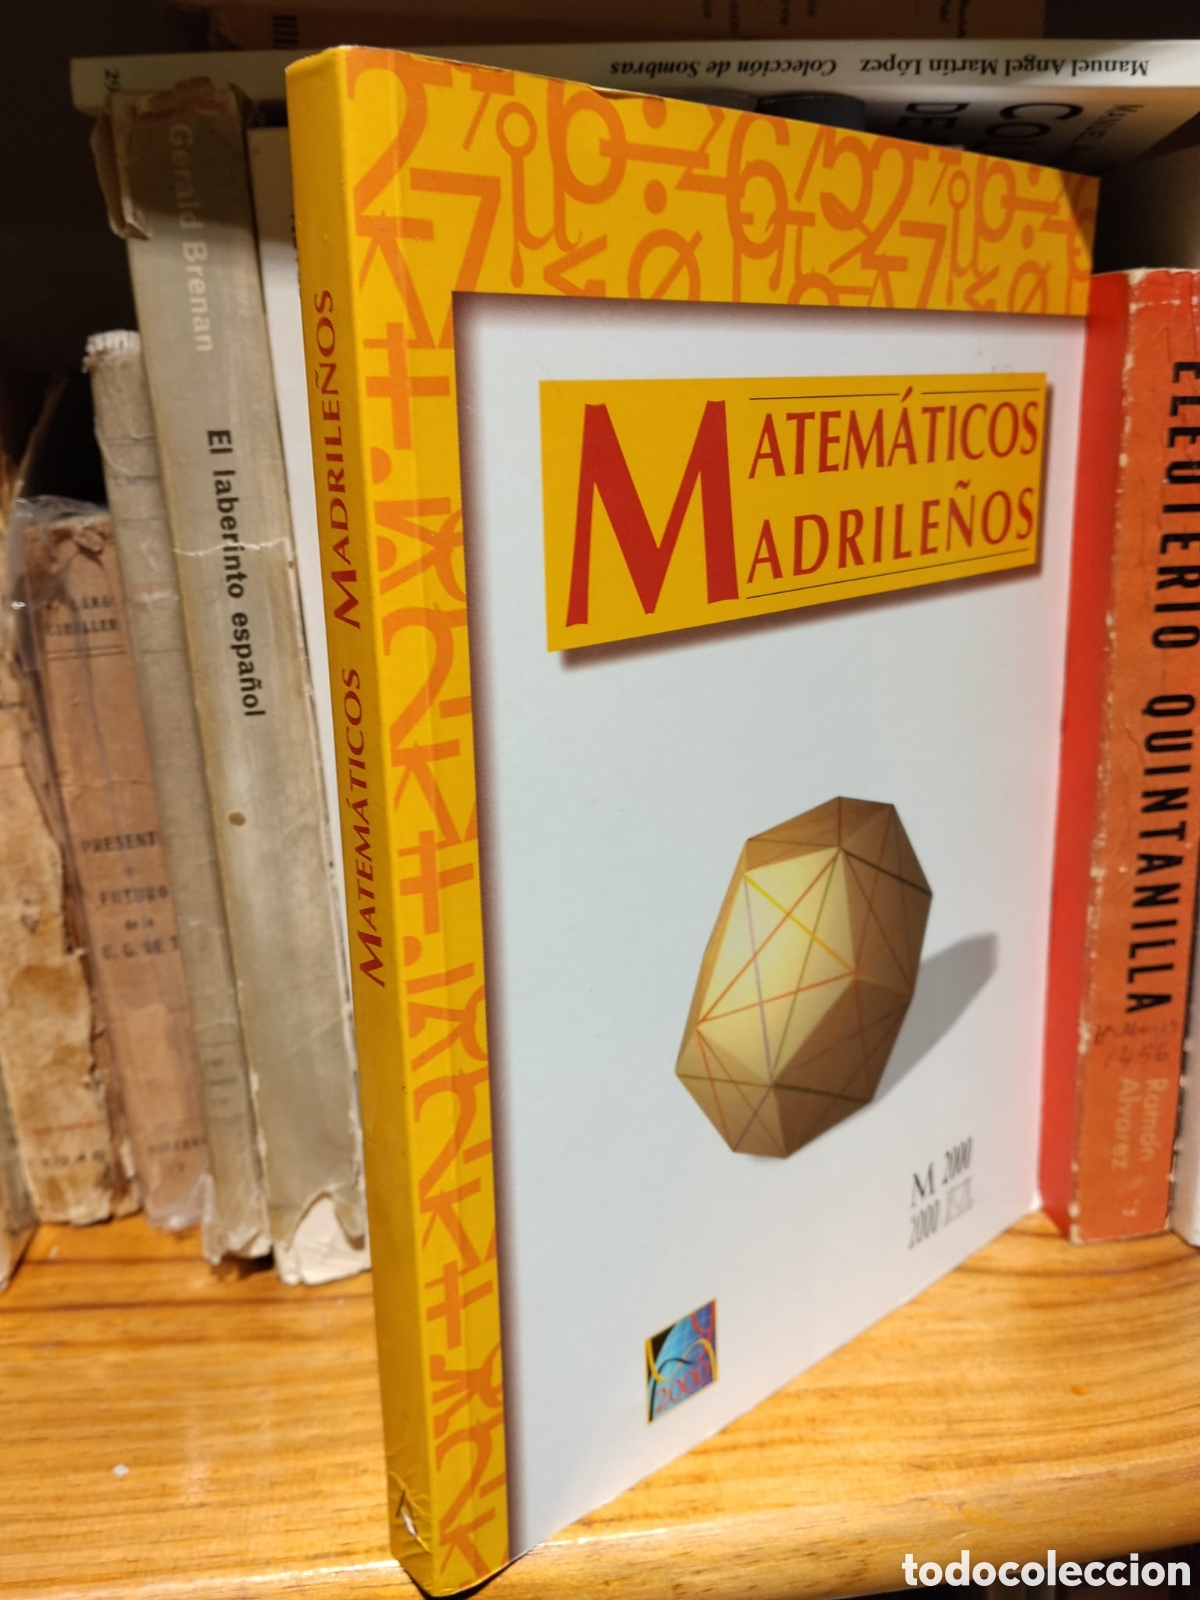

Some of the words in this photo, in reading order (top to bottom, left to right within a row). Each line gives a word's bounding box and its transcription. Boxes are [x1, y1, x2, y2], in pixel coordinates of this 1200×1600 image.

[610, 59, 700, 78] Sombras
[706, 60, 731, 78] de
[738, 58, 837, 78] Colección
[860, 54, 922, 77] López
[929, 56, 999, 77] Martín
[1004, 54, 1065, 76] Angel
[1071, 58, 1150, 77] Manuel
[169, 122, 203, 230] Gerald
[181, 240, 213, 352] Brenan
[207, 429, 234, 455] El
[314, 289, 361, 630] MADRILEÑOS
[213, 469, 247, 600] laberinto
[231, 611, 267, 718] español
[342, 668, 386, 988] MATEMÁTICOS
[1126, 694, 1196, 1014] QUINTANILLA
[1111, 1077, 1141, 1170] Alvarez
[1139, 1077, 1170, 1162] Ramón
[942, 1136, 972, 1185] 2000
[655, 1360, 711, 1413] 2000
